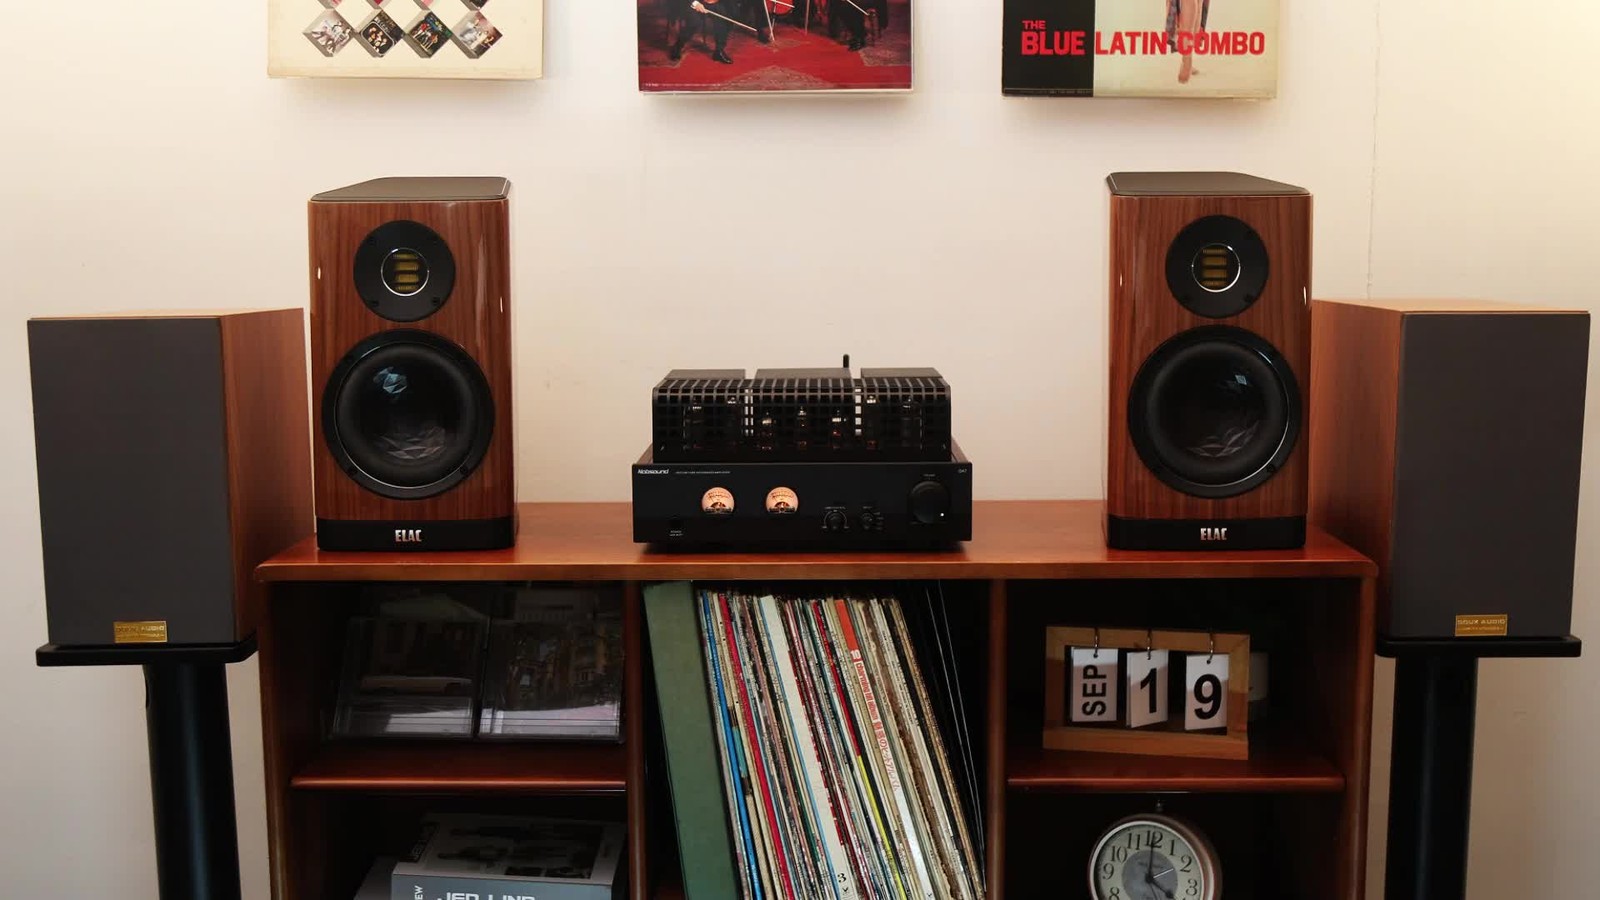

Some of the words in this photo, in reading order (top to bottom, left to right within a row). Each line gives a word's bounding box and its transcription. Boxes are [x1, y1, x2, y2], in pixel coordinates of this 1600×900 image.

[1022, 20, 1046, 30] THE
[1021, 31, 1085, 56] BLUE
[1095, 31, 1167, 56] LATIN
[1177, 31, 1265, 56] COMBO
[395, 529, 422, 542] ELAC
[1200, 527, 1228, 541] ELAC
[1082, 664, 1107, 716] SEP
[1140, 667, 1157, 714] 1
[1194, 673, 1222, 720] 9
[1127, 832, 1141, 850] 11
[1144, 830, 1164, 848] 12
[1169, 839, 1175, 856] 1
[1111, 845, 1128, 863] 10
[1102, 863, 1115, 880] 9
[1180, 855, 1192, 873] 2
[1186, 879, 1198, 896] 3
